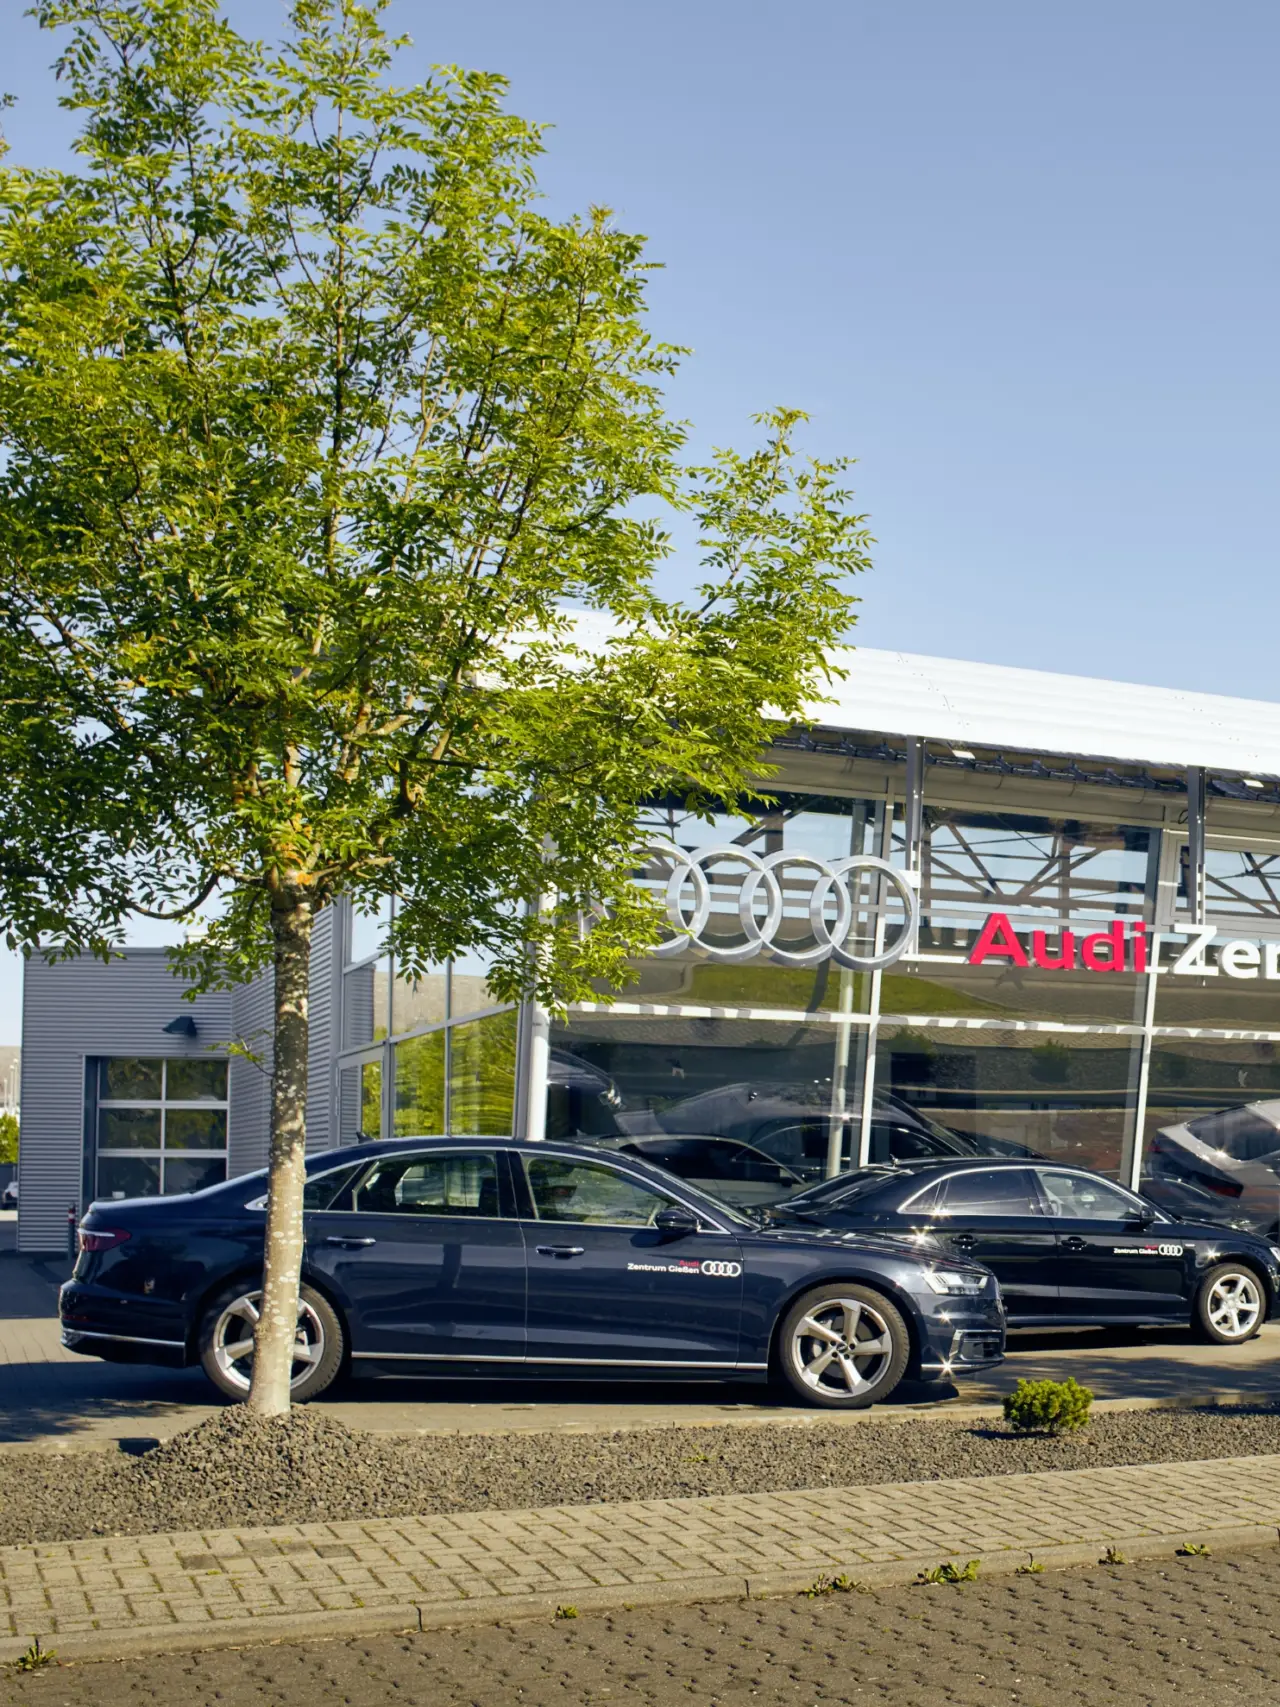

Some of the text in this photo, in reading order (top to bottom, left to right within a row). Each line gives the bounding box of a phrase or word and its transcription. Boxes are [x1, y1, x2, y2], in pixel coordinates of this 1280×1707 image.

[968, 912, 1146, 973] Audi
[627, 1263, 699, 1274] Zentrum Gießen
